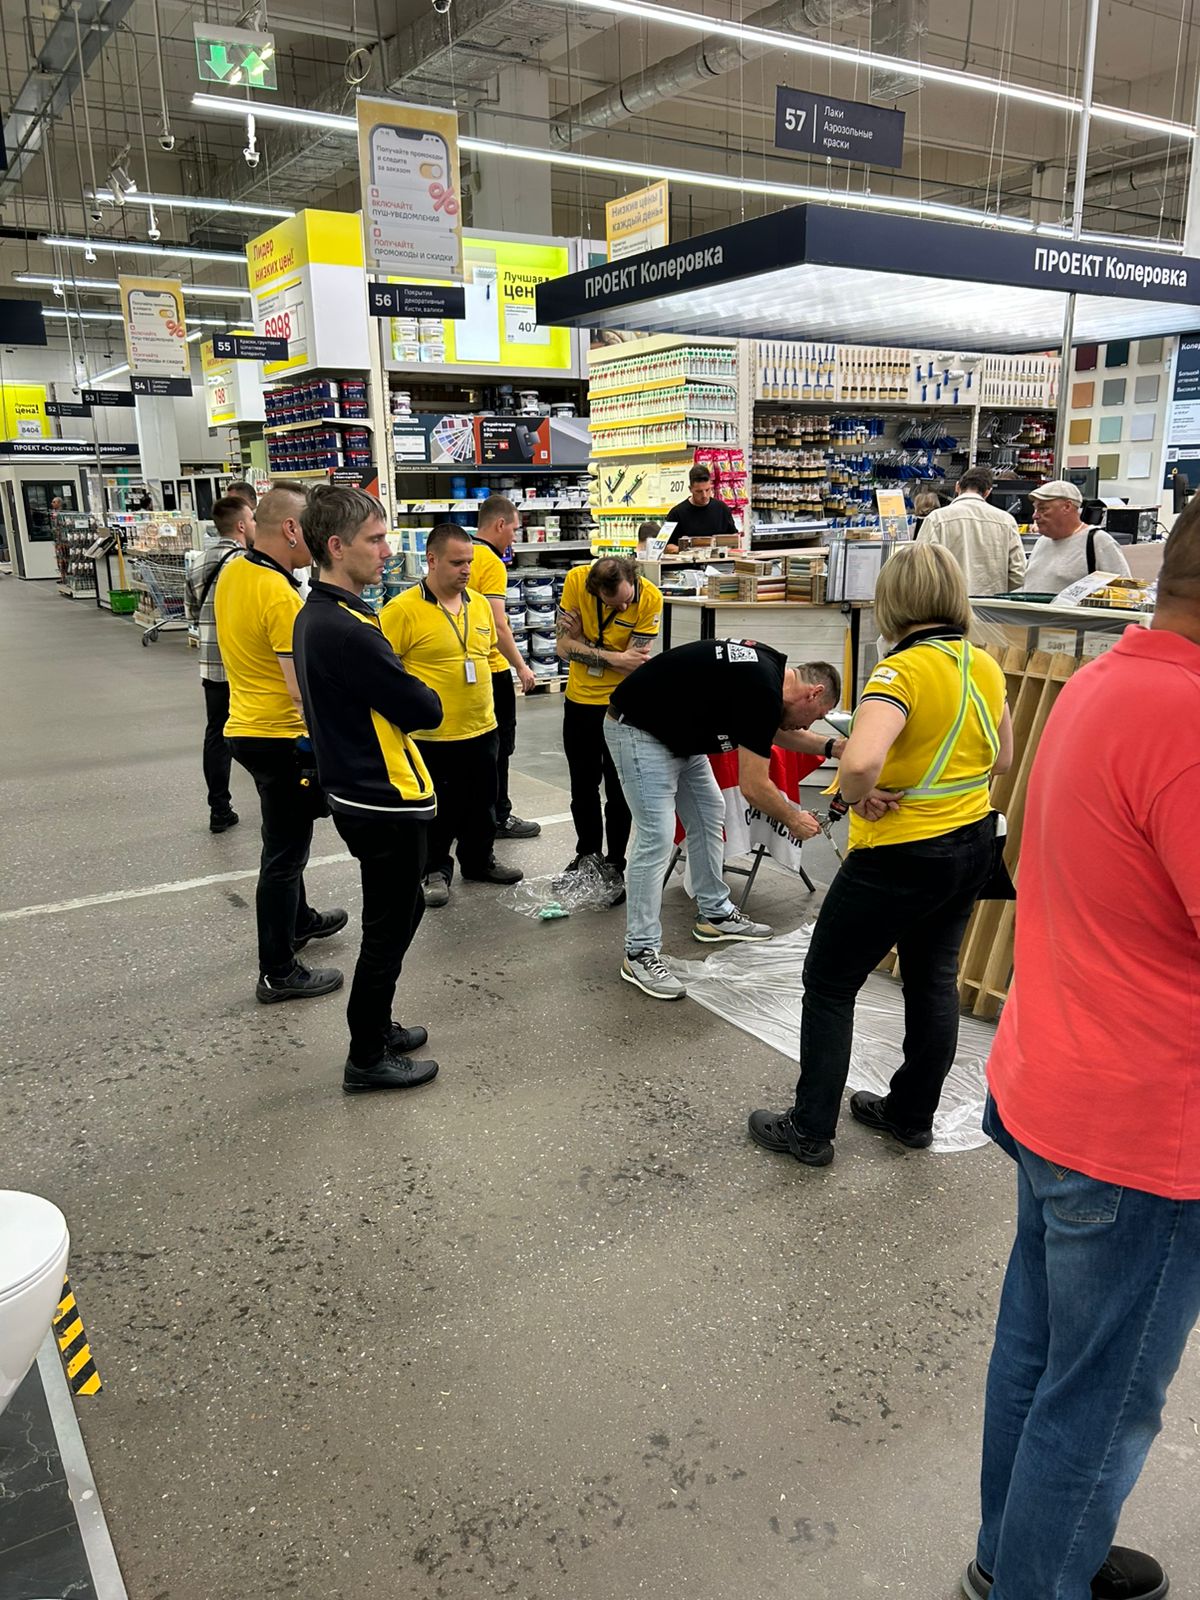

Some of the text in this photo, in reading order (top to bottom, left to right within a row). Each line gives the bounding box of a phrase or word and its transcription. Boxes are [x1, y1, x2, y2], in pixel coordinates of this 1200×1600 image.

[824, 106, 844, 119] Лаки
[785, 108, 806, 131] 57
[823, 121, 873, 140] Аэрозольные
[823, 137, 850, 150] краски
[376, 145, 409, 156] Получайте
[372, 200, 413, 211] ВКЛЮЧАЙТЕ
[611, 193, 658, 218] Низкие цены
[372, 209, 440, 223] ПУШ-УВЕДОМЛЕНИЯ
[612, 212, 642, 232] каждый
[253, 239, 274, 261] Лидер
[374, 239, 415, 249] ПОЛУЧАЙТЕ
[374, 248, 419, 260] ПРОМОКОДЫ
[426, 253, 454, 262] СКИДКИ
[255, 248, 295, 282] низких цен!
[1034, 248, 1188, 288] ПРОЕКТ Колеровка
[504, 271, 543, 284] Лучшая
[585, 265, 637, 299] ПРОЕКТ
[640, 246, 723, 284] Колеровка
[404, 288, 433, 297] Покрытия
[504, 284, 534, 301] цен
[375, 294, 392, 306] 56
[404, 297, 446, 305] декоративные
[404, 306, 422, 314] Кисти,
[518, 321, 537, 333] 407
[217, 341, 231, 351] 55
[134, 382, 146, 390] 54
[16, 404, 39, 415] цена!
[41, 444, 94, 453] «Строительство
[670, 480, 685, 493] 207
